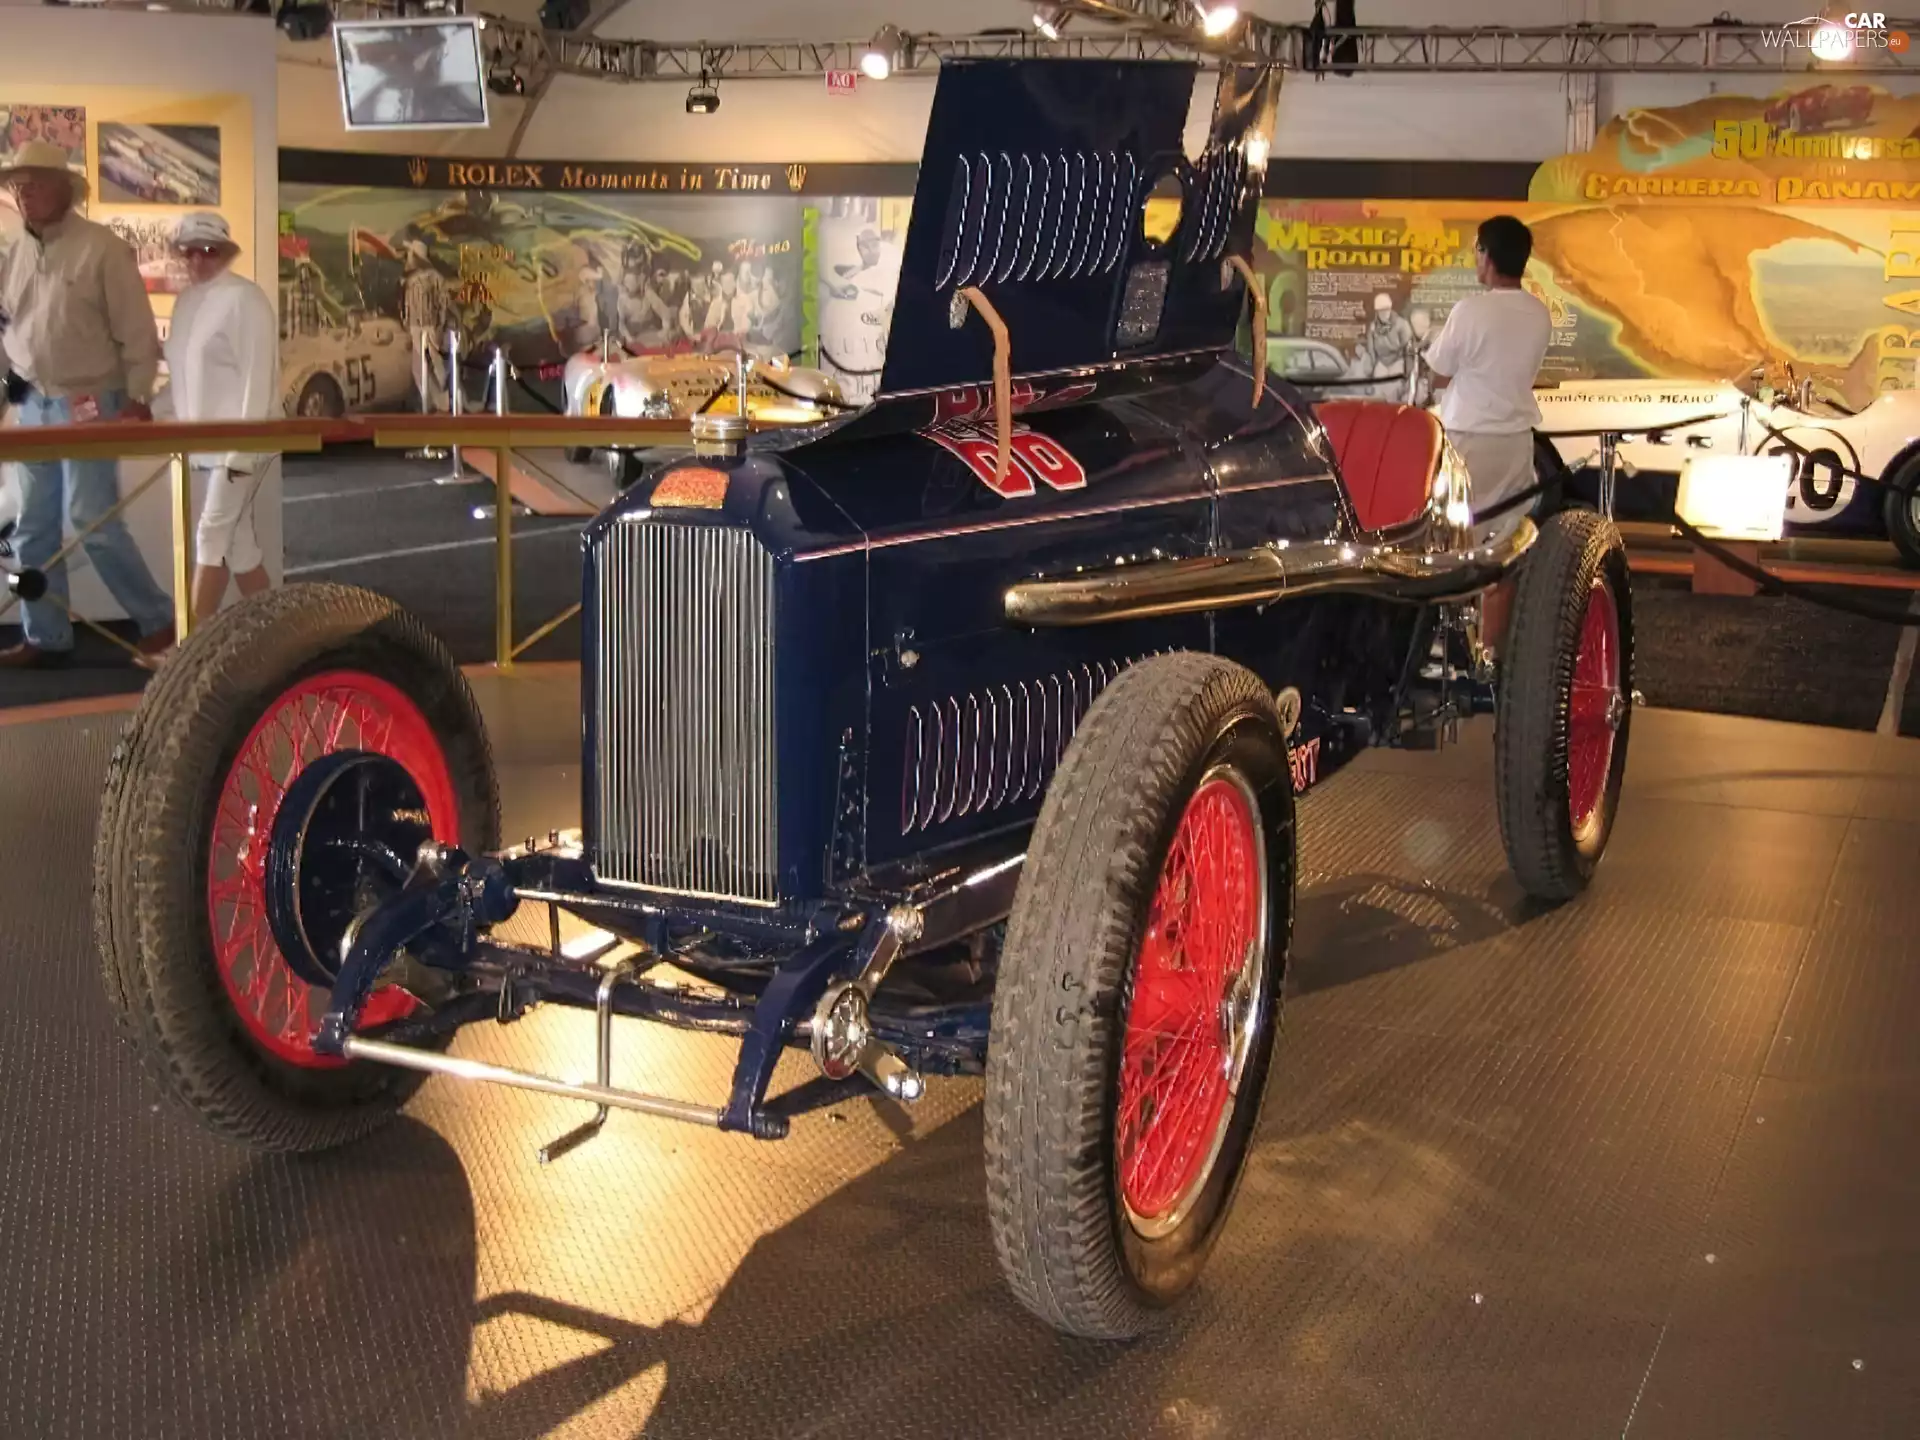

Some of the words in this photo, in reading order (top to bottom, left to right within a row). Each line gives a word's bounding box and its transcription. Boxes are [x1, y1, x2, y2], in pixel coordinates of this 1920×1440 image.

[448, 163, 544, 187] ROLEX
[560, 166, 669, 189] Moments
[680, 168, 702, 189] in
[714, 168, 771, 190] Time
[1585, 172, 1761, 199] CARRERA
[1267, 219, 1460, 252] MEXICAN
[1306, 247, 1391, 270] ROAD
